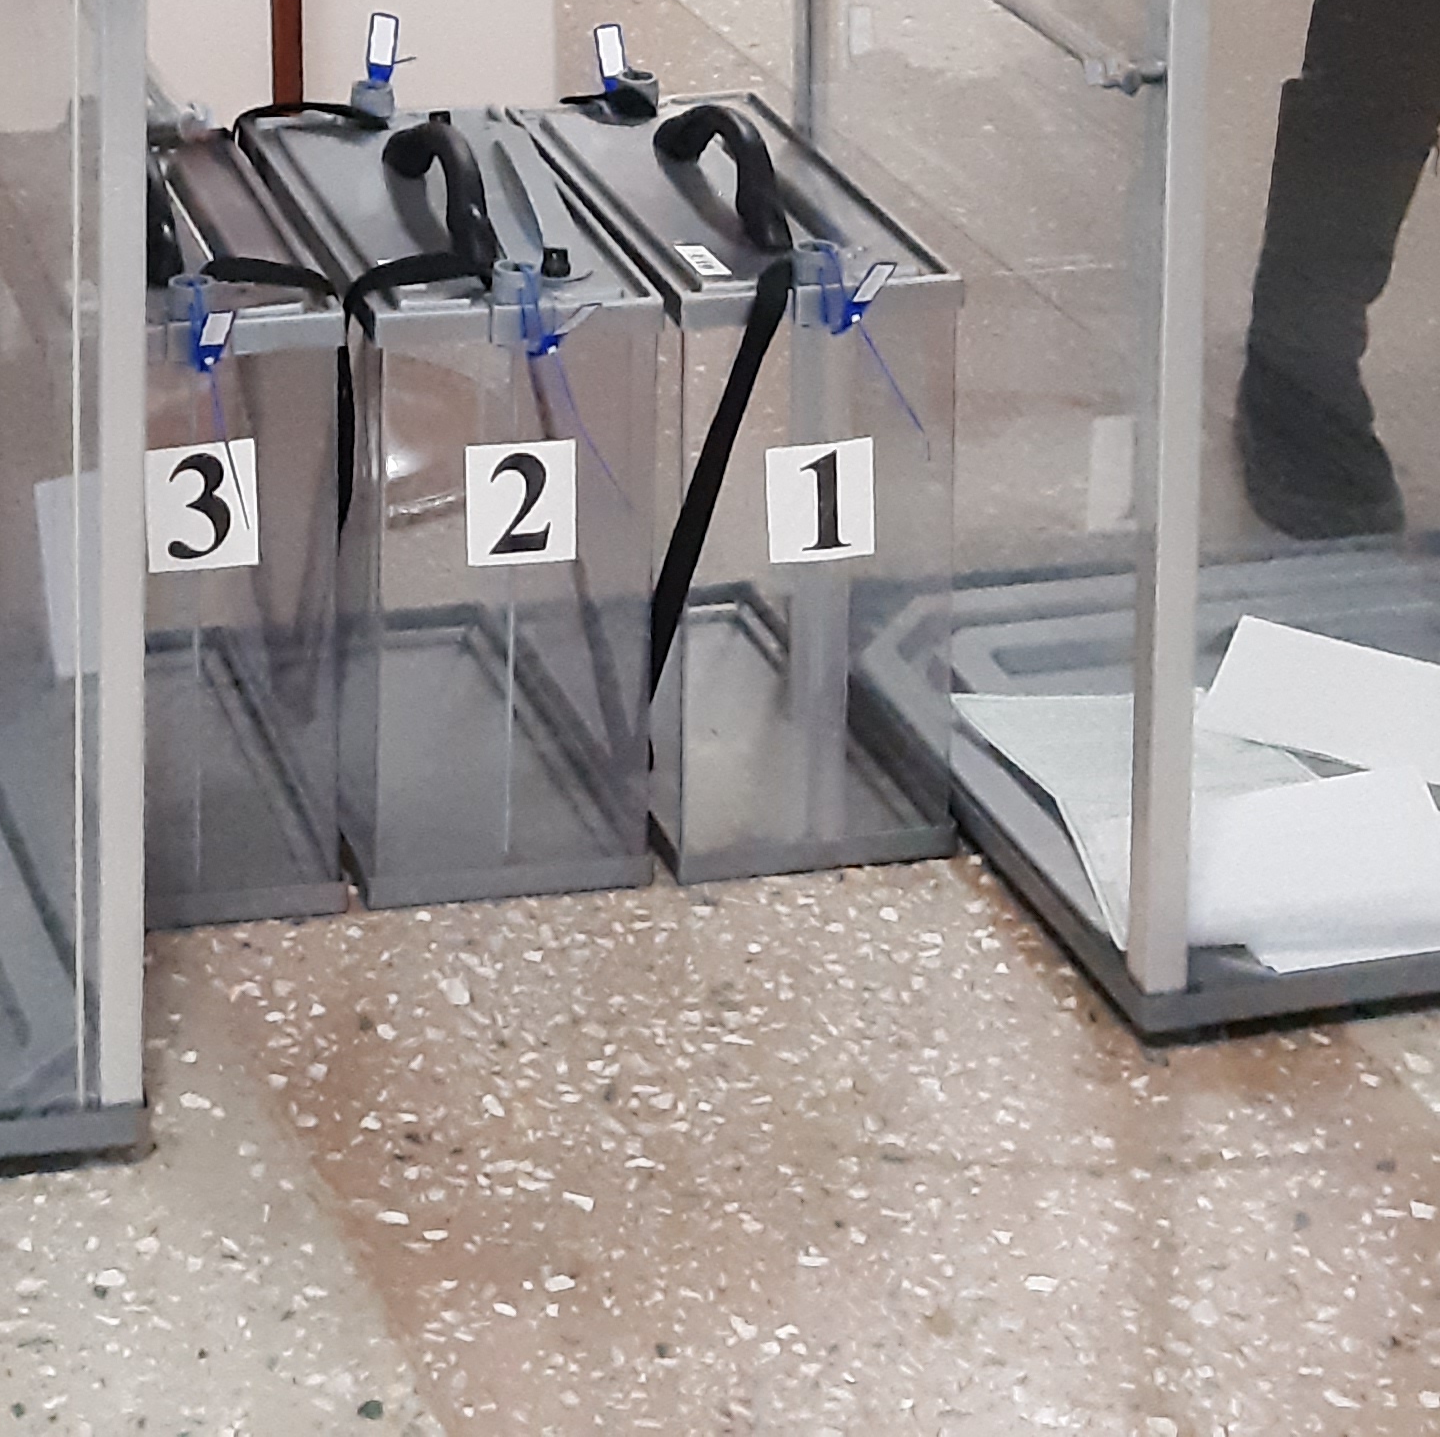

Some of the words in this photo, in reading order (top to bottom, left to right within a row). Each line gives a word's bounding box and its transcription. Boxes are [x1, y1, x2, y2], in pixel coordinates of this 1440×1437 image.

[167, 452, 232, 560] 3
[489, 452, 552, 555] 2
[799, 448, 852, 552] 1
